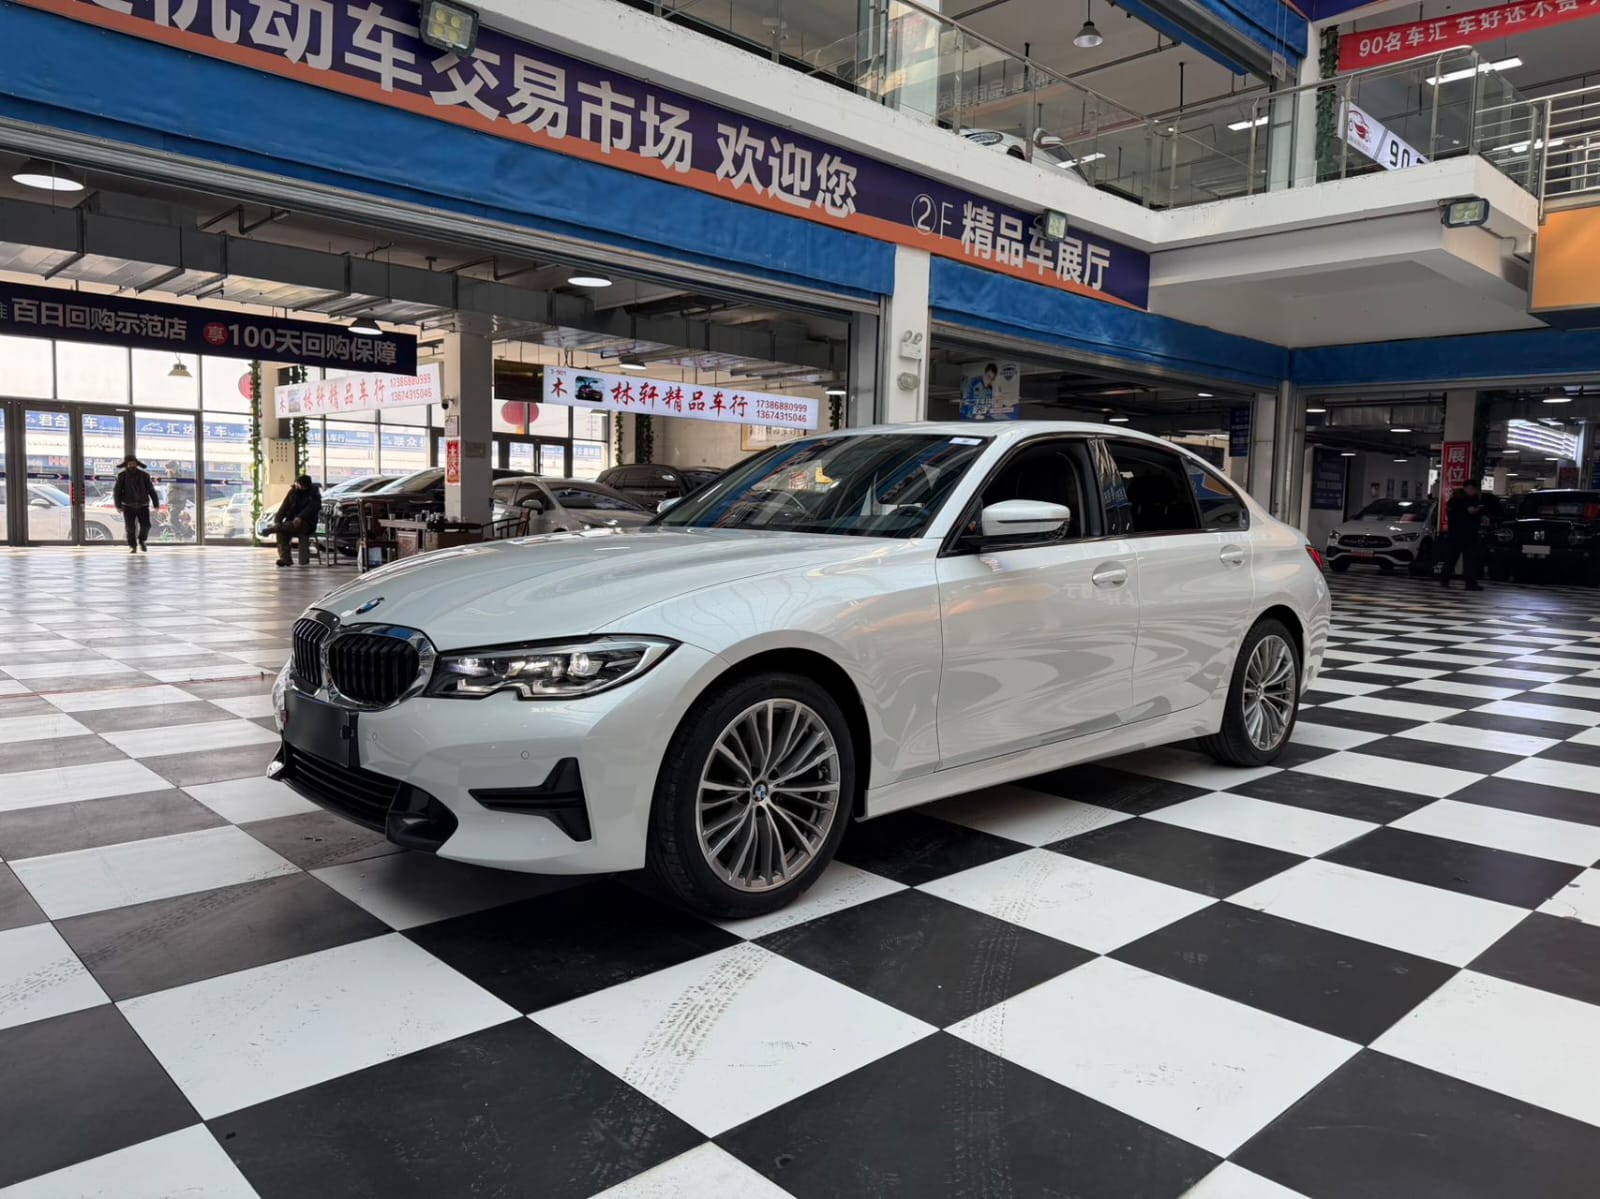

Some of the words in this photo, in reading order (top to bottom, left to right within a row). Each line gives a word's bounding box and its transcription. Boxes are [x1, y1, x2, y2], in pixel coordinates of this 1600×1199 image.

[1359, 20, 1448, 57] 90名车汇
[93, 0, 693, 174] 动车交易市场
[715, 122, 858, 219] 欢迎您
[1389, 140, 1425, 170] 90
[961, 200, 1111, 291] 精品车展厅
[11, 297, 188, 342] 百日回购示范店
[610, 381, 749, 419] 林轩精品车行
[756, 399, 808, 413] 17386880999
[756, 409, 808, 423] 13674315046
